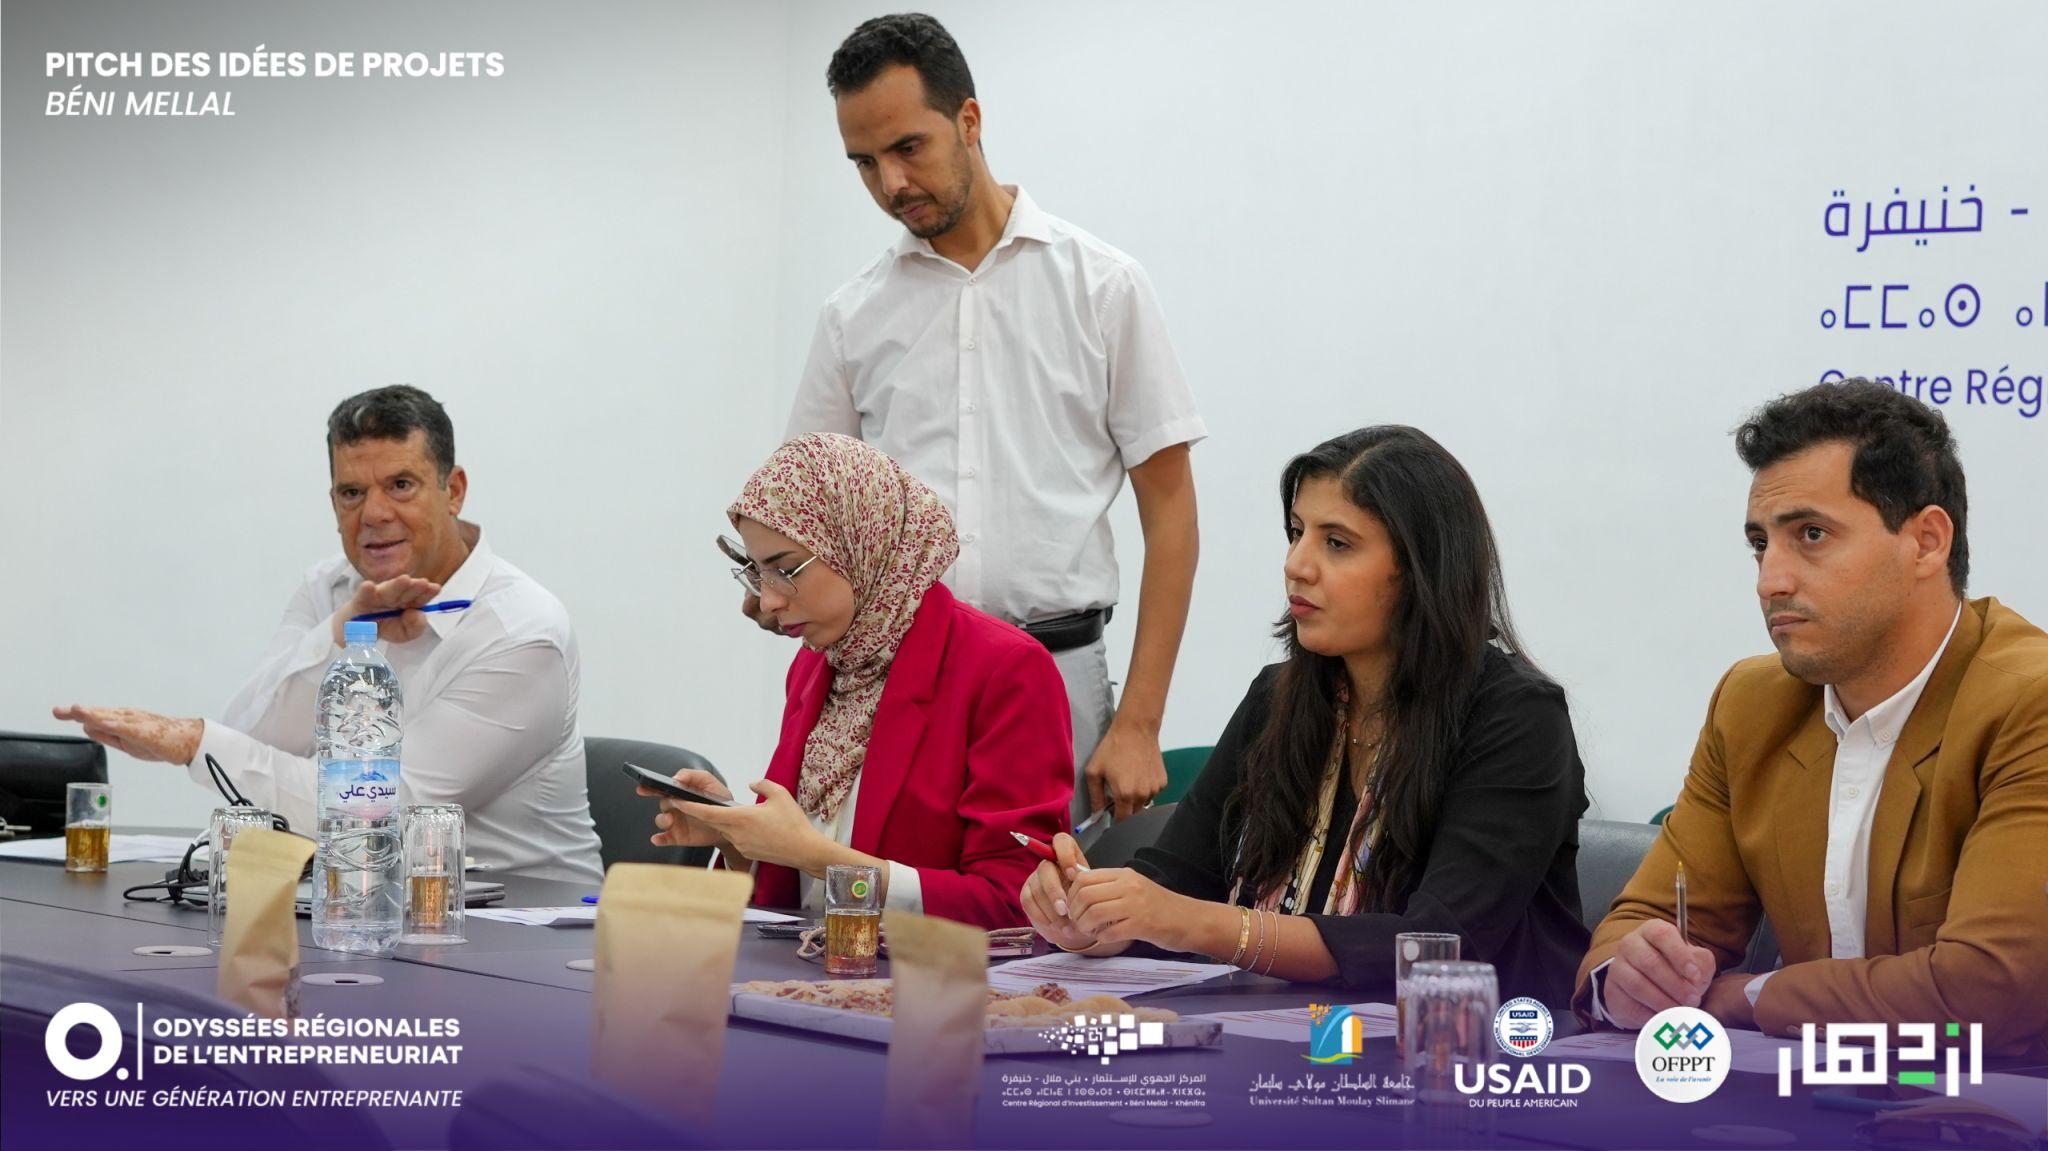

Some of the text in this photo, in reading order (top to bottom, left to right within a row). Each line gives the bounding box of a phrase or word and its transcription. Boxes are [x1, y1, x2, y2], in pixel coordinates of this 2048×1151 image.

[1824, 184, 1983, 252] خنيفرة
[1820, 364, 2048, 418] tre Rég
[339, 784, 365, 804] علي
